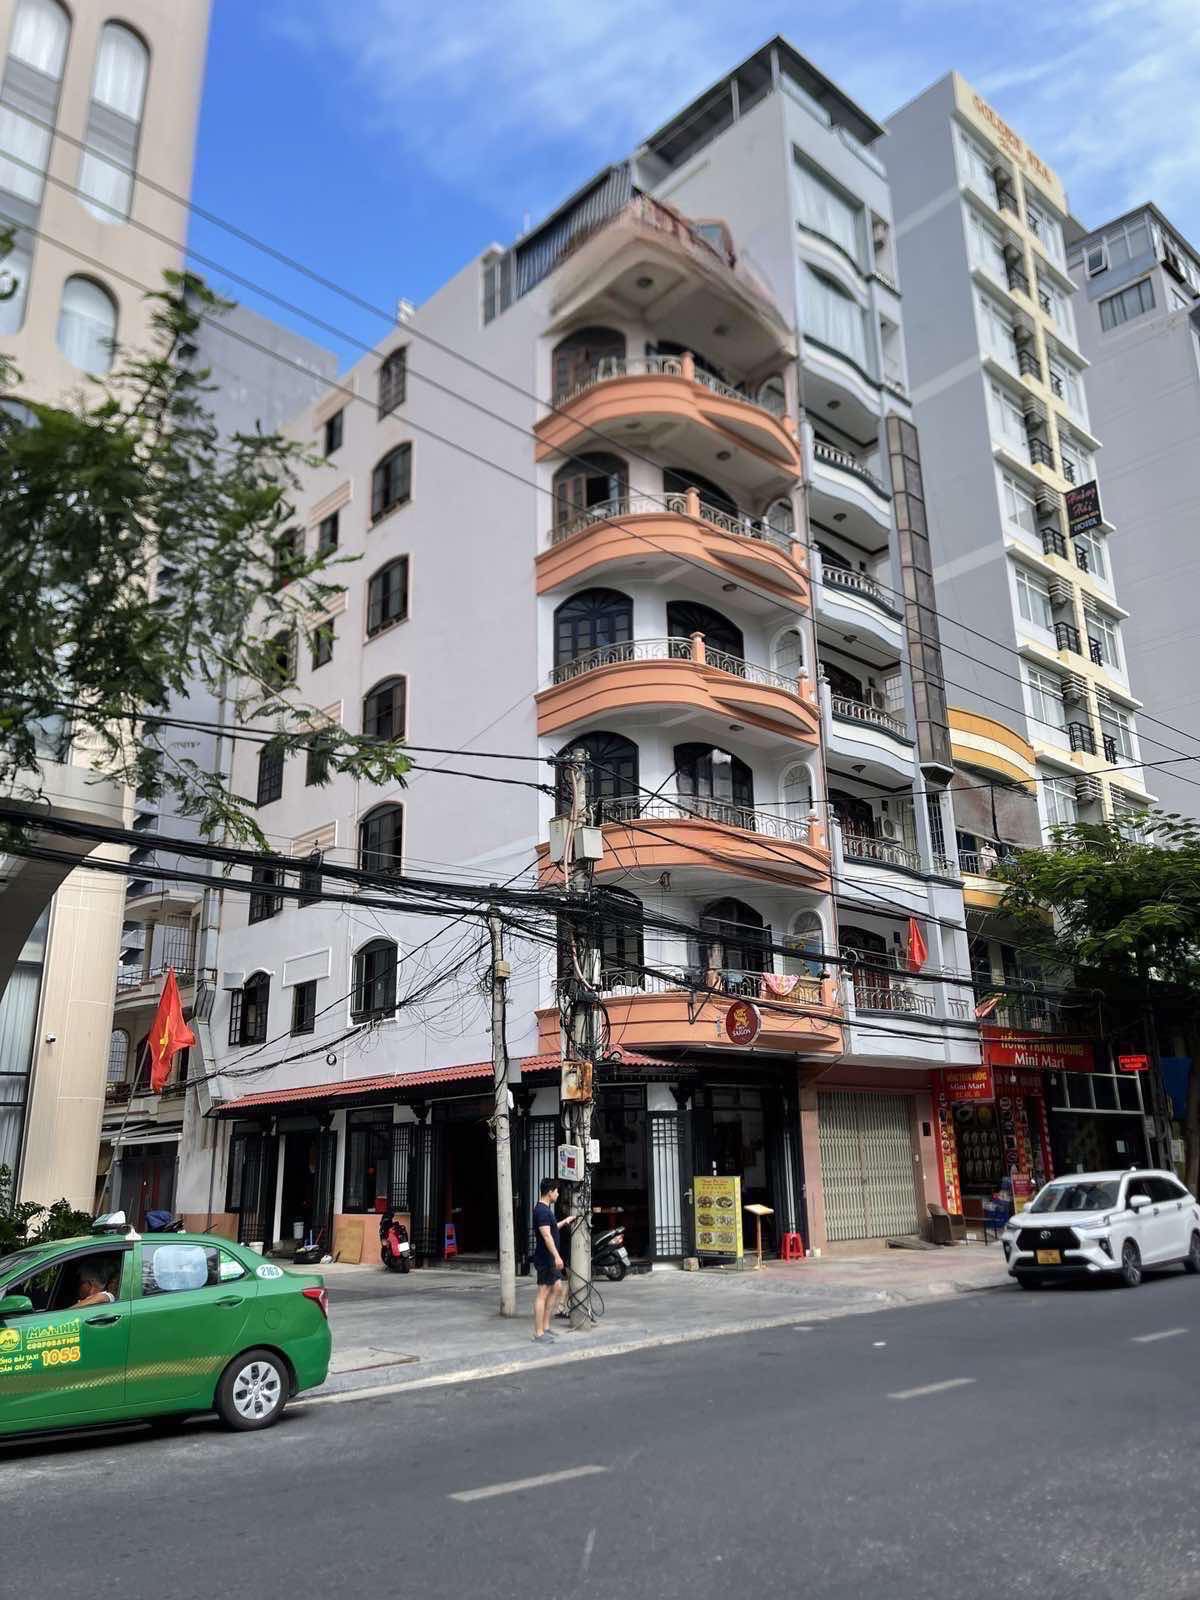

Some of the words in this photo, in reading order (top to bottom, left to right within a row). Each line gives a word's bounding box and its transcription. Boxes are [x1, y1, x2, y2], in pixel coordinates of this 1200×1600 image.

[1014, 1051, 1038, 1066] Mini
[1041, 1055, 1065, 1069] Mart
[26, 1353, 39, 1361] TAXI
[42, 1346, 81, 1366] 1055
